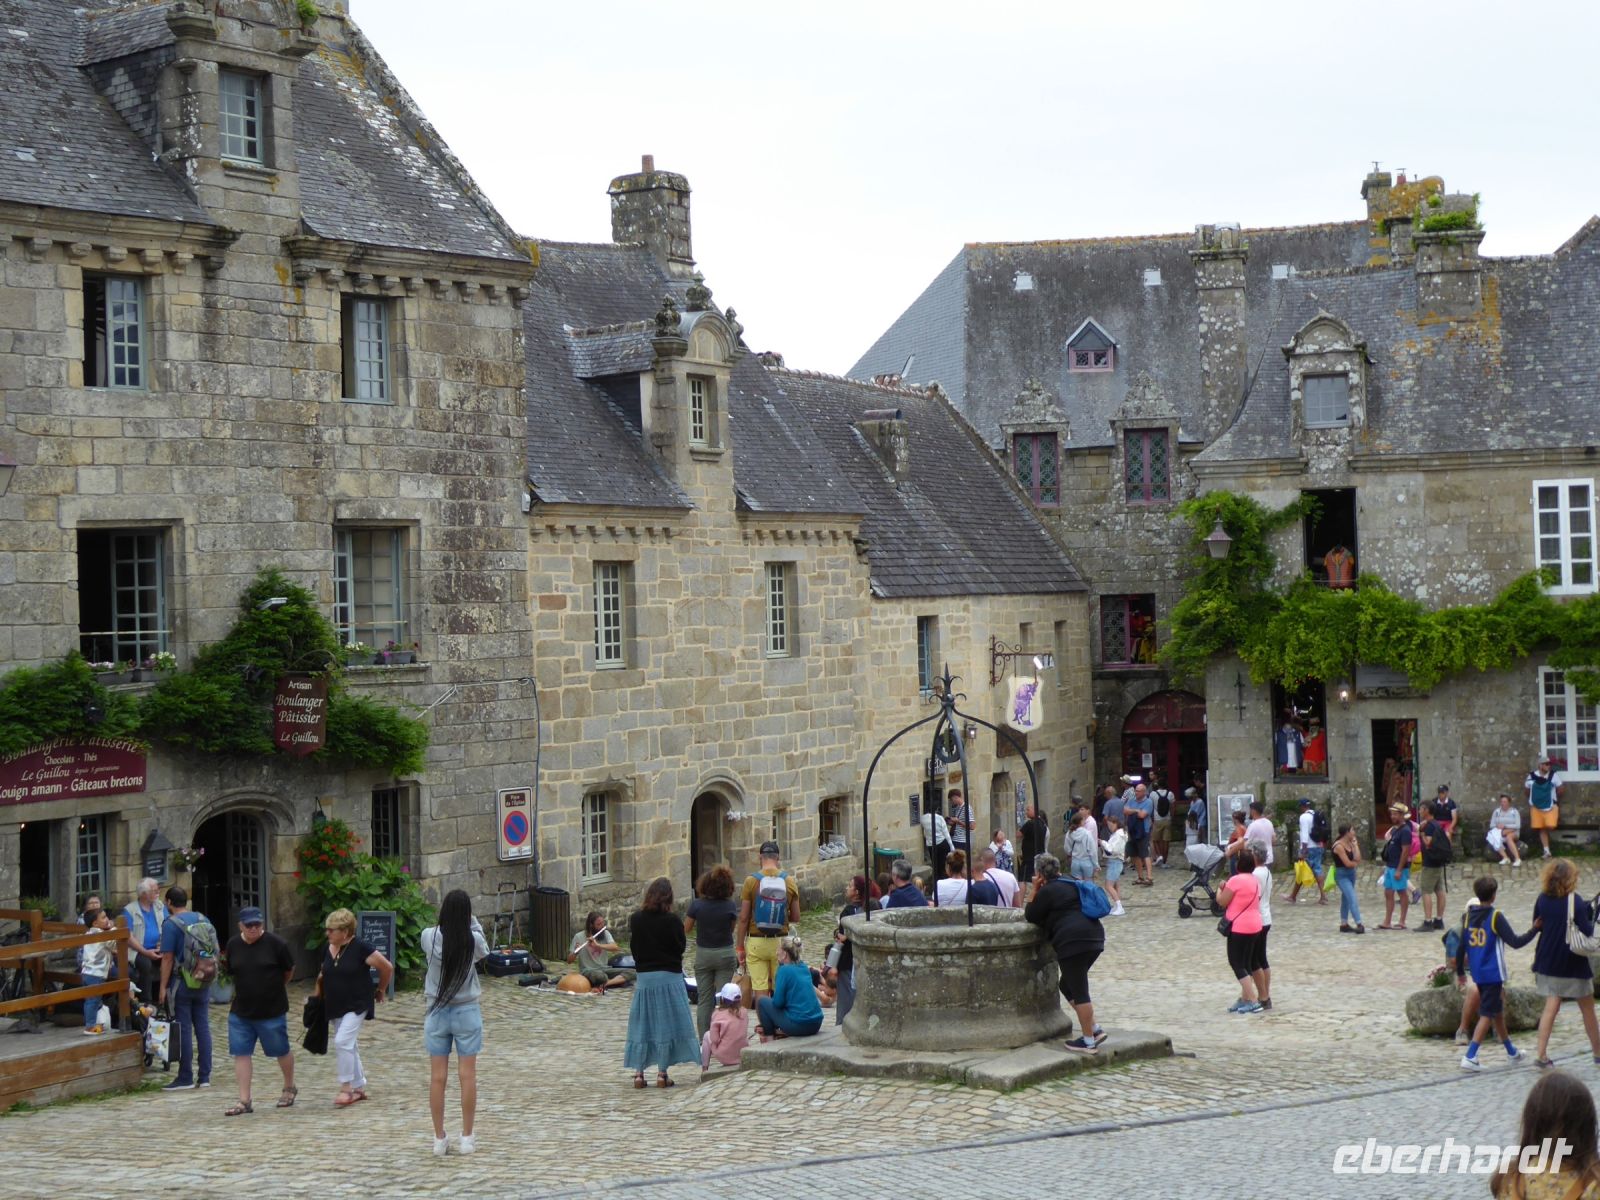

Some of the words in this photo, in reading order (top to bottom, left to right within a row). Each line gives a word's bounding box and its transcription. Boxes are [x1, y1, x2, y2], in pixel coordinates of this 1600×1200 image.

[288, 681, 312, 690] Artisan
[276, 693, 324, 712] Boulanger
[279, 710, 321, 723] Pâtissier
[280, 731, 290, 741] Le
[292, 730, 319, 744] Guillou
[44, 755, 75, 766] Chocolats
[84, 752, 98, 762] Thés
[21, 770, 34, 781] Le
[36, 766, 70, 783] Guillou
[31, 784, 62, 795] amann
[71, 778, 108, 791] Gâteaux
[110, 775, 143, 788] bretons
[1469, 928, 1487, 946] 30
